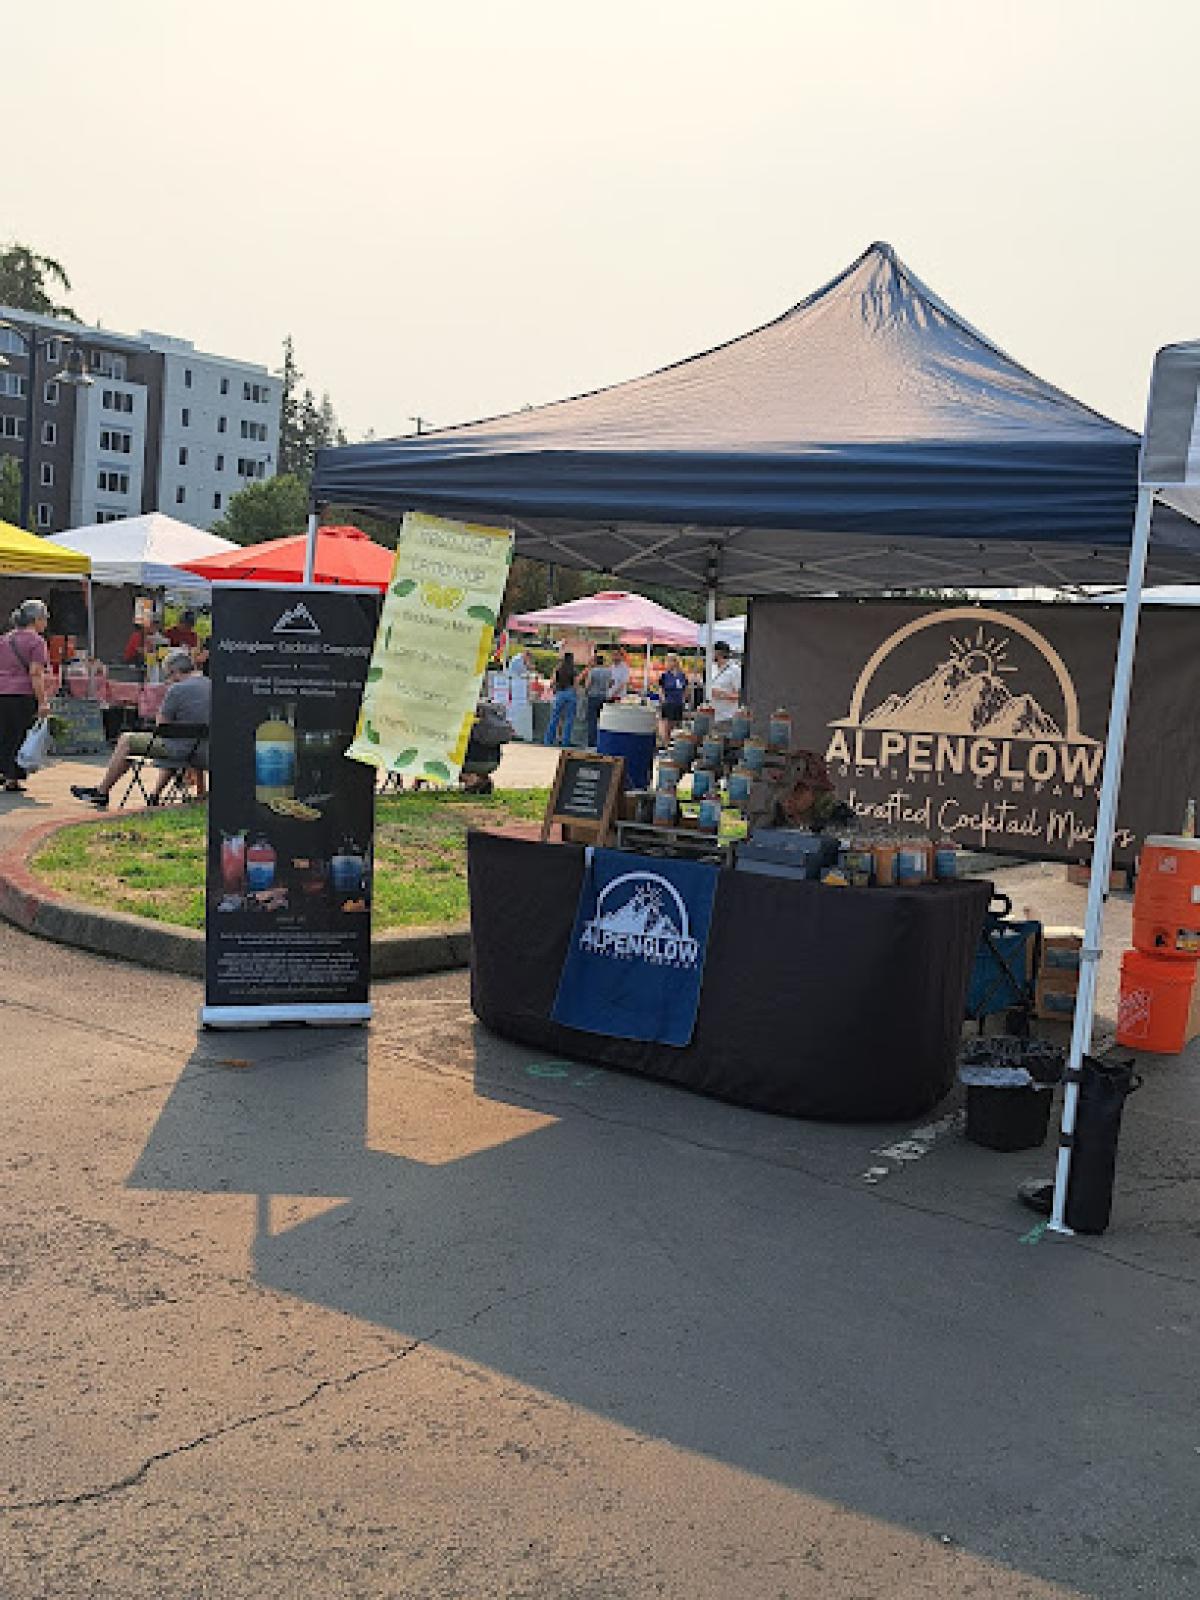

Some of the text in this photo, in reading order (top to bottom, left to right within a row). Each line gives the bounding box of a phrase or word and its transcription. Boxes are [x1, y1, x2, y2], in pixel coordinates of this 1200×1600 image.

[218, 638, 274, 654] Alpenglow
[825, 728, 1104, 787] ALPENGLOW
[937, 797, 1043, 848] Cocktail
[578, 923, 699, 963] ALPENGLOW
